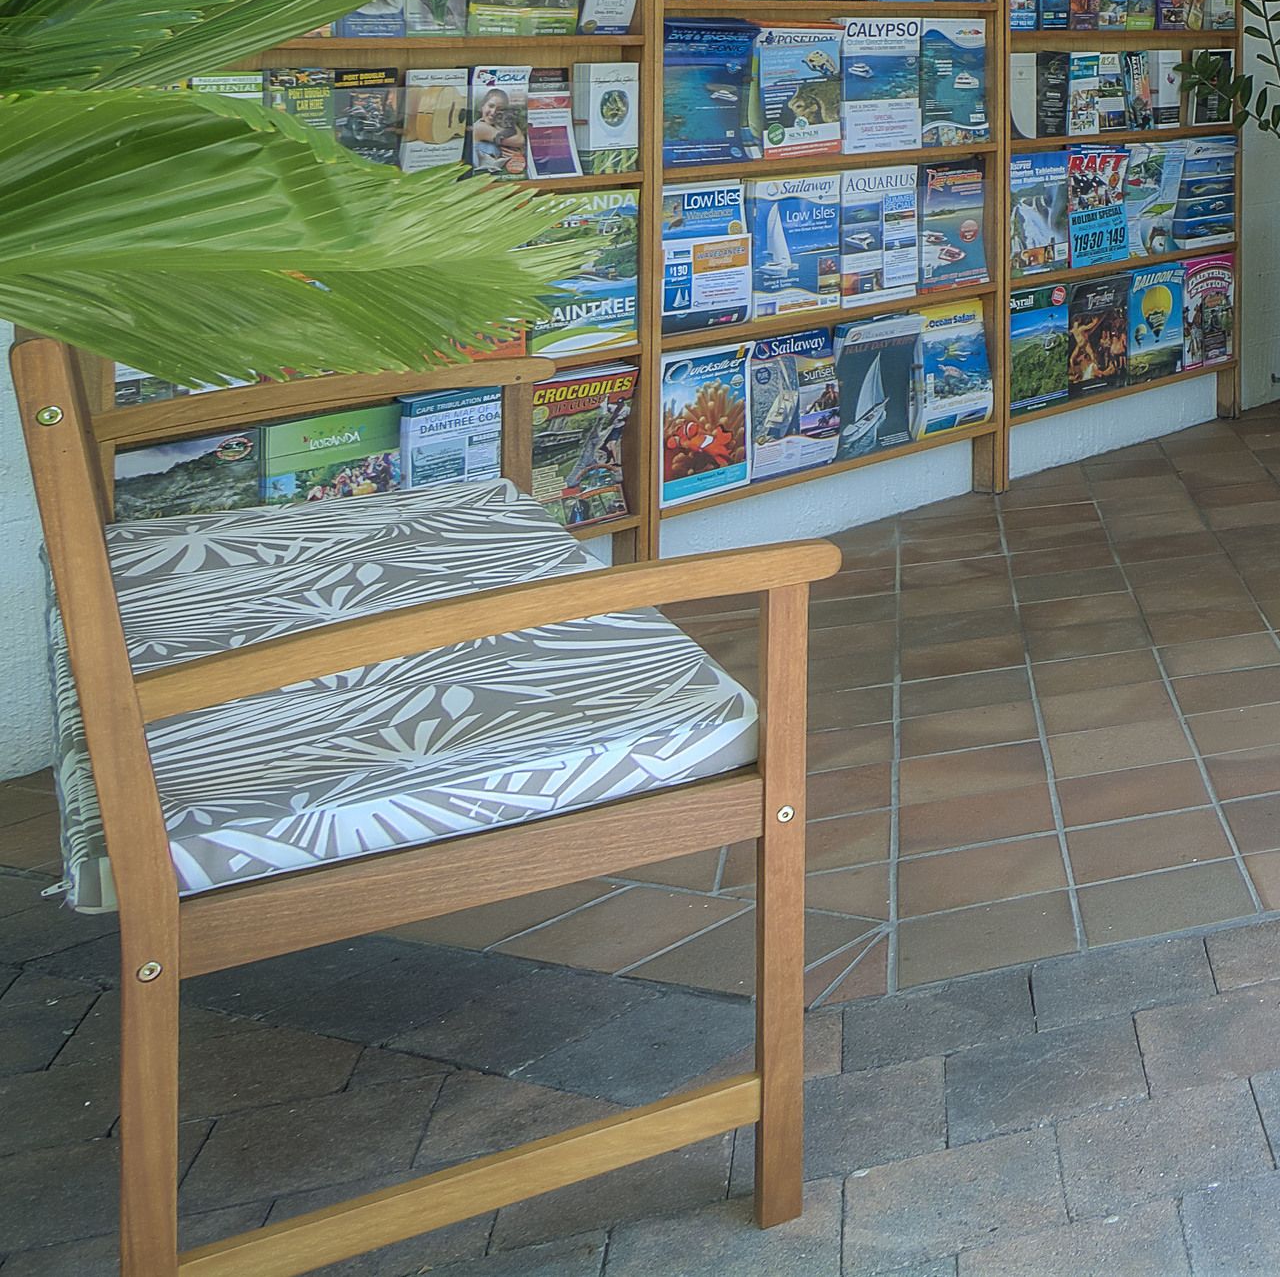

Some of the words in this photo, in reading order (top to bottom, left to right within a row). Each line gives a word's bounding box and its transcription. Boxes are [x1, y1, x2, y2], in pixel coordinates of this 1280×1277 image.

[776, 33, 838, 45] POSEIDON
[846, 21, 919, 38] CALYPSO
[1068, 154, 1129, 176] RAFT
[780, 179, 835, 197] Sailaway
[845, 173, 916, 194] AQUARIUS
[683, 192, 714, 210] Low
[715, 189, 742, 207] Isles
[786, 210, 810, 223] Low
[813, 205, 836, 220] Isles
[1071, 211, 1099, 226] HOLIDAY
[1099, 206, 1122, 221] SPECIAL
[1132, 270, 1171, 292] BALLOON
[534, 296, 636, 326] AINTREE
[771, 336, 826, 357] Sailaway
[665, 357, 746, 384] Quicksilver
[803, 366, 835, 386] Sunset
[533, 376, 634, 405] CROCODILES
[416, 405, 435, 415] CAPE
[436, 398, 482, 411] TRIBULATION
[420, 415, 475, 435] DAINTREE
[309, 429, 361, 451] KURANDA
